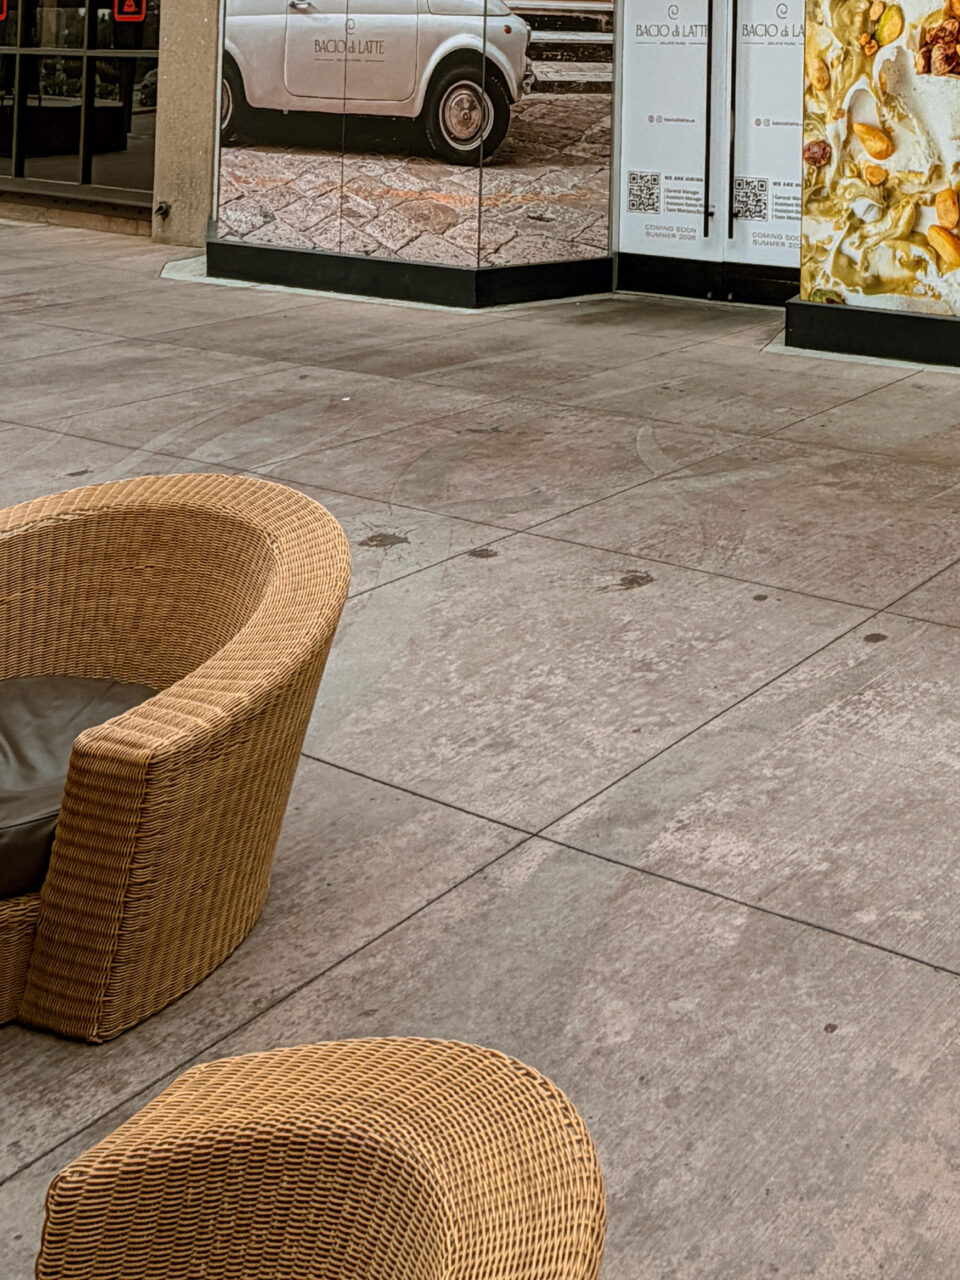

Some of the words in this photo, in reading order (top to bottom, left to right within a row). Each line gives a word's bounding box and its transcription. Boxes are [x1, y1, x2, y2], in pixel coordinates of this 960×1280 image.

[636, 24, 669, 37] BACIO
[742, 24, 778, 37] BACIO
[315, 40, 346, 53] BACIO
[358, 40, 384, 54] LATTE
